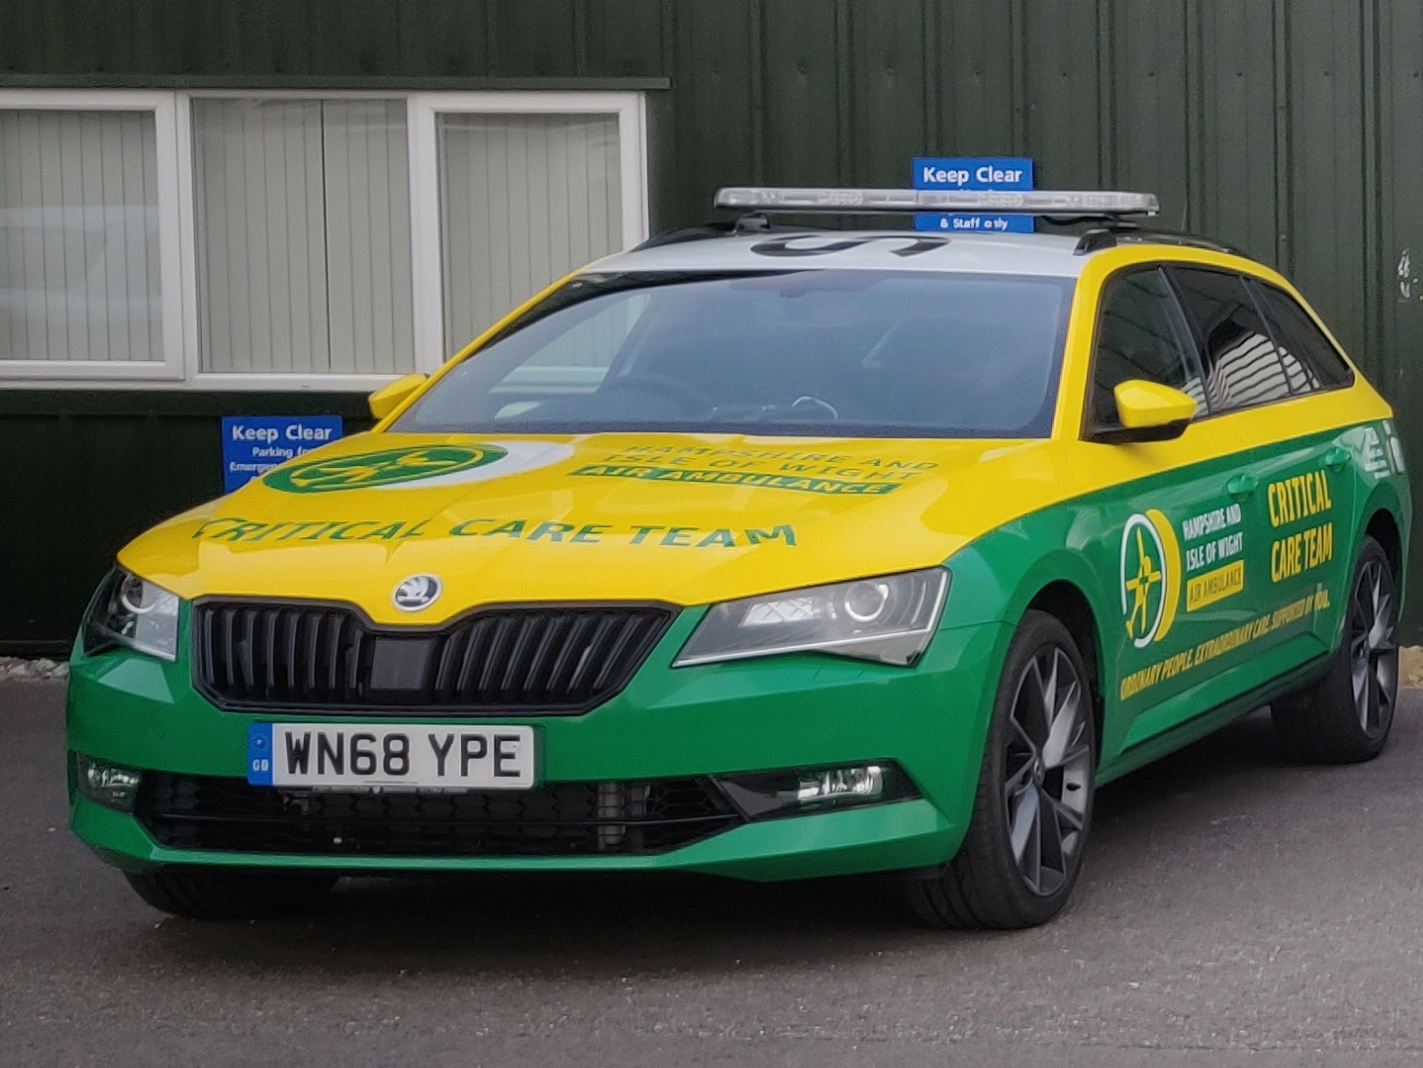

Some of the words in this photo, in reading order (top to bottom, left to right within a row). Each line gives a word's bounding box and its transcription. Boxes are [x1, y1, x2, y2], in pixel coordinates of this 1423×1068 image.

[923, 166, 970, 186] Keep
[976, 165, 1023, 183] Clear
[953, 217, 981, 229] Staff
[231, 424, 279, 445] Keep
[285, 423, 333, 441] Clear
[251, 446, 293, 459] Parking
[624, 444, 854, 465] HAMPSHIRE
[861, 458, 940, 471] AND
[590, 467, 654, 479] AIR
[659, 470, 891, 495] AMBULANCE
[603, 454, 697, 468] ISLE
[714, 458, 767, 469] OF
[780, 462, 925, 481] WIGHT
[1267, 468, 1332, 528] CRITICAL
[192, 516, 433, 542] CRITICAL
[449, 518, 614, 544] CARE
[627, 522, 797, 549] TEAM
[1182, 507, 1226, 541] HAMPSHIRE
[1226, 503, 1242, 527] AND
[1186, 546, 1205, 573] ISLE
[1206, 541, 1217, 565] OF
[1218, 531, 1243, 559] WIGHT
[1271, 532, 1303, 583] CARE
[1303, 522, 1333, 571] TEAM
[1203, 567, 1242, 598] AMBULANCE
[284, 731, 410, 776] WN68
[427, 733, 522, 777] YPE
